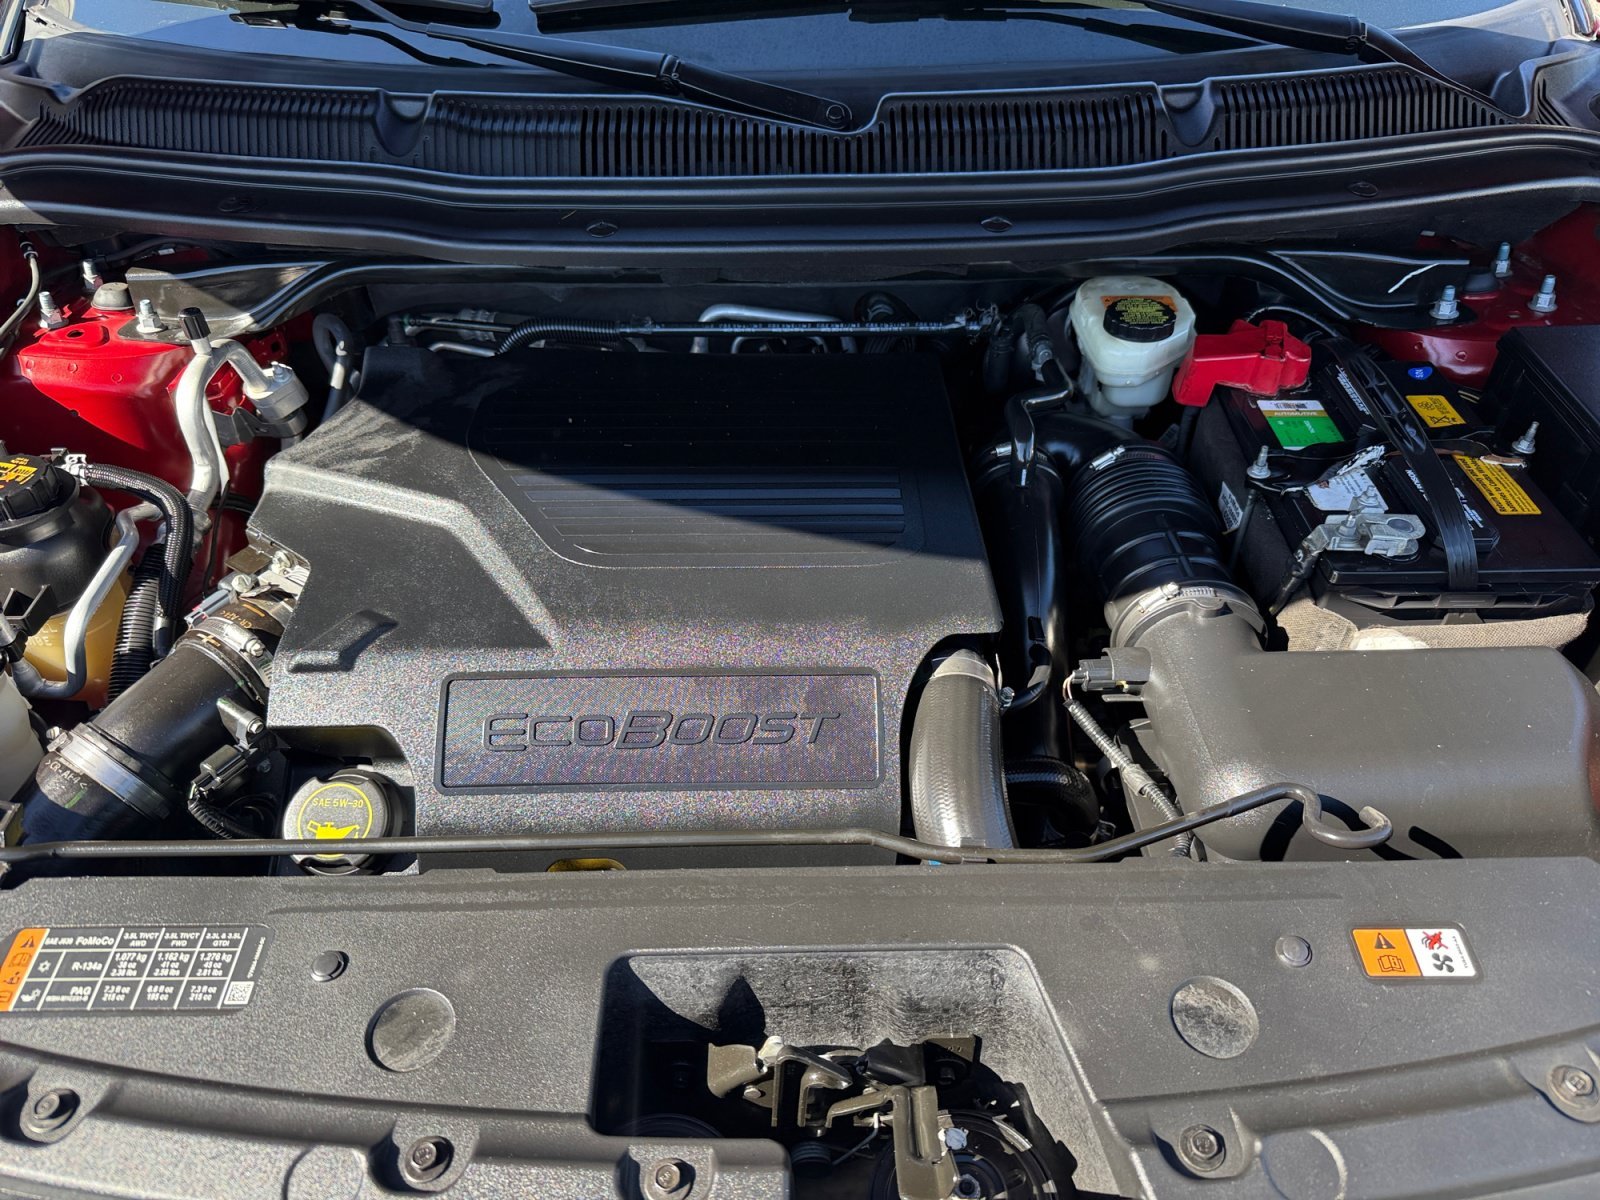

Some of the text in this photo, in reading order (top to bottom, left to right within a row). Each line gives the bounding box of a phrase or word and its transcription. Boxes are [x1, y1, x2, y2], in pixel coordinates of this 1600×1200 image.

[312, 797, 364, 808] SAE 5W-30
[75, 936, 115, 946] FoMoCo
[115, 952, 148, 963] 1.077 kg
[178, 952, 190, 963] kg
[221, 952, 232, 963] kg
[71, 961, 103, 971] R-134a
[160, 961, 170, 969] 41
[169, 968, 180, 976] lbs
[70, 986, 92, 996] PAG
[121, 986, 131, 994] oz
[164, 986, 174, 994] oz
[207, 986, 217, 994] oz
